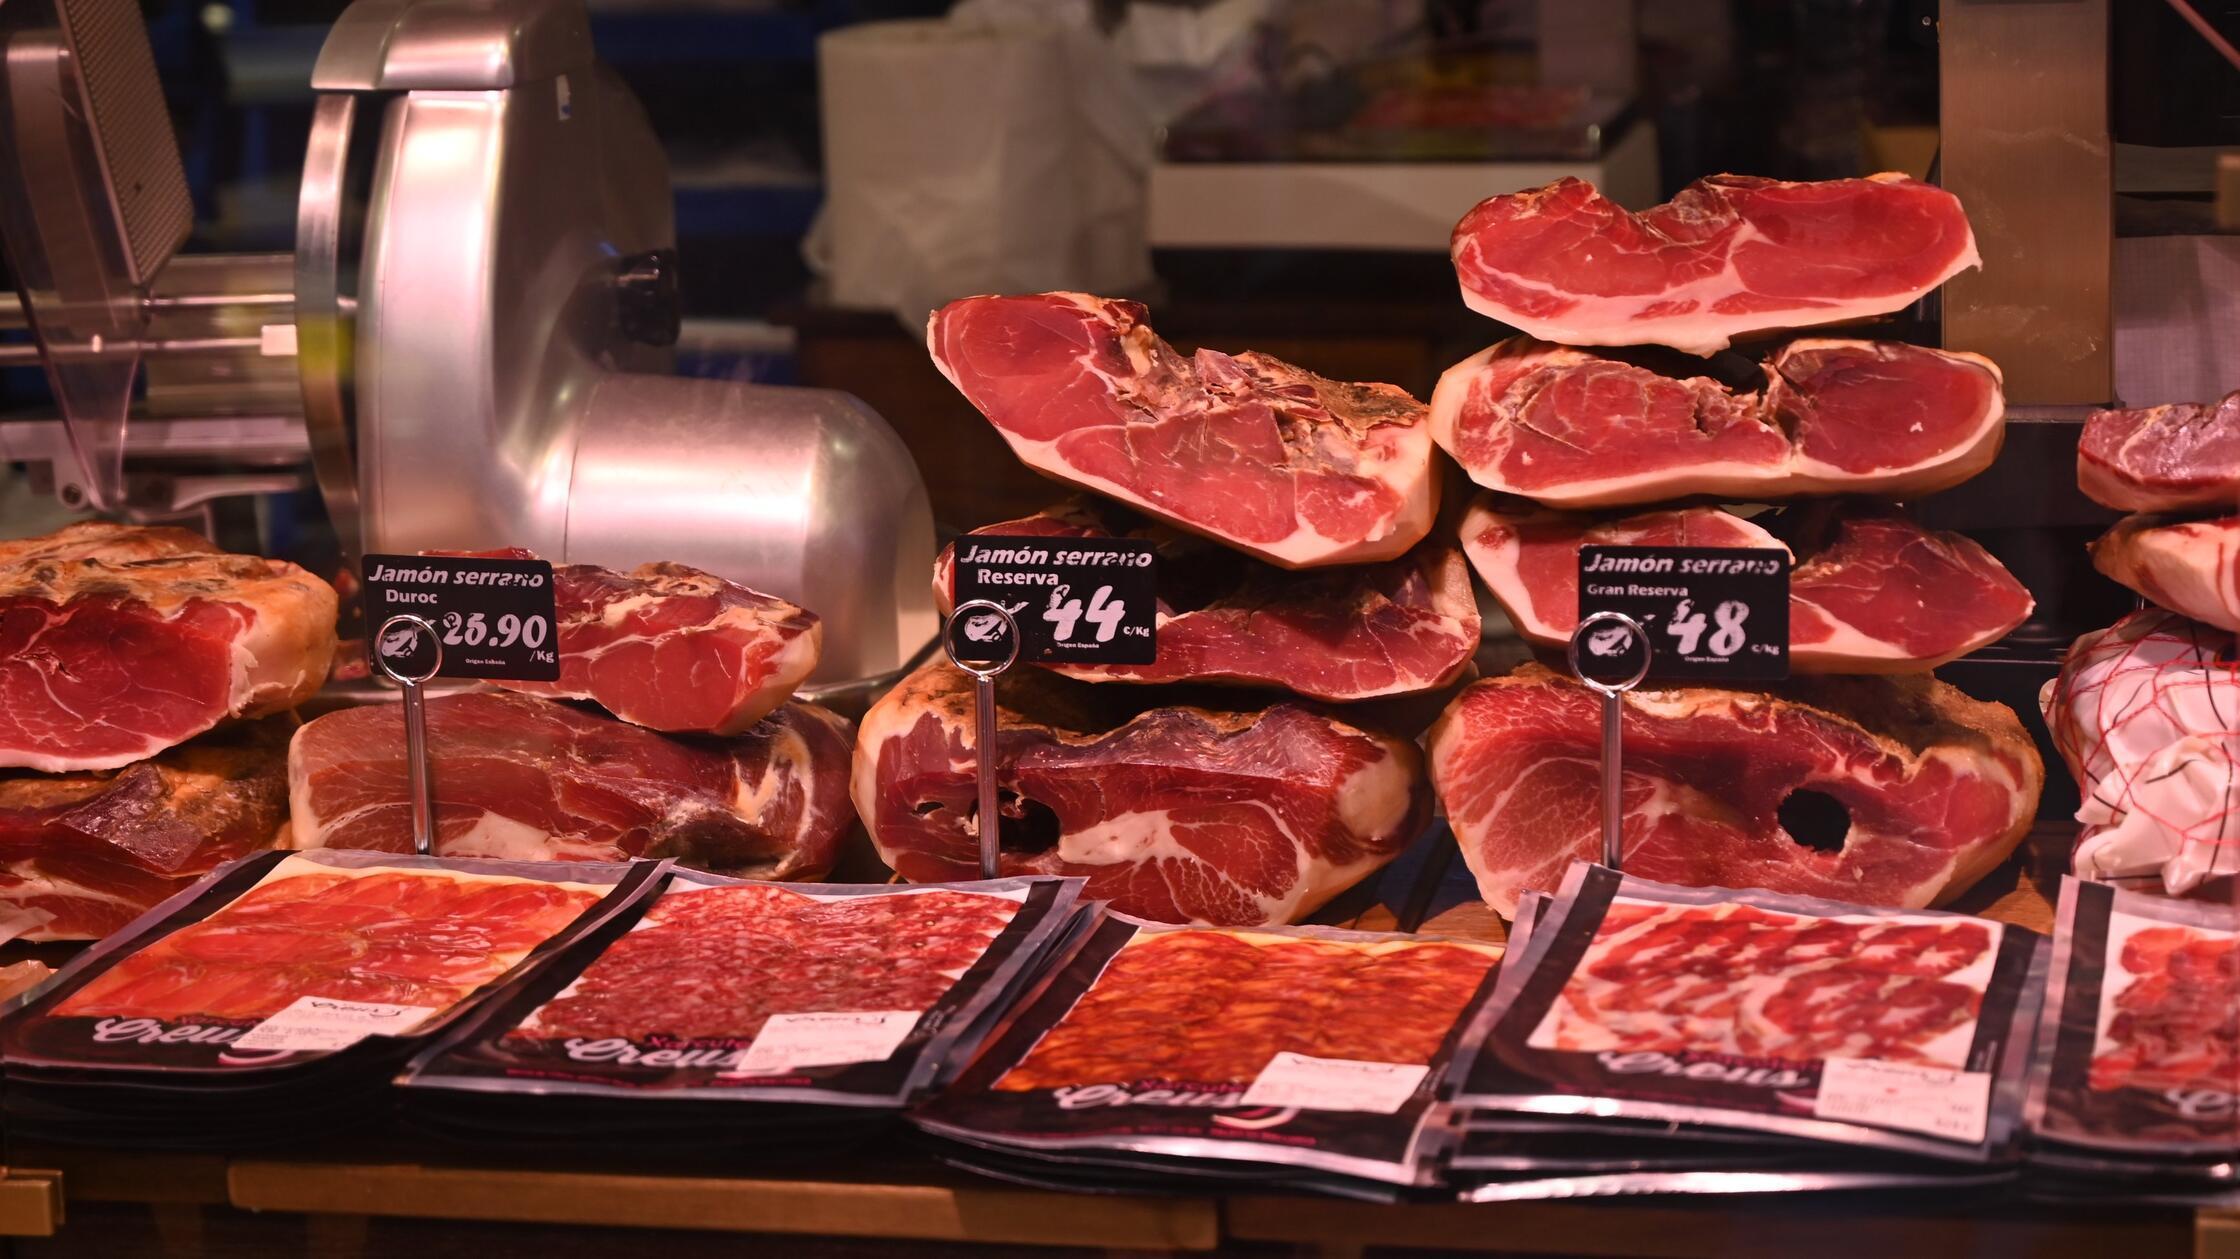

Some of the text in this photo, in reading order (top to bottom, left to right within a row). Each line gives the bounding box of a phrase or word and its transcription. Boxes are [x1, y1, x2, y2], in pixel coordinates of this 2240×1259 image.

[960, 545, 1049, 565] Jamón
[1584, 553, 1675, 573] Jamón
[368, 564, 448, 584] Jamón
[977, 568, 1059, 586] Reserva
[385, 589, 438, 604] Duroc
[1587, 583, 1689, 597] Gran Reserva
[1042, 584, 1126, 642] 44
[442, 611, 555, 663] 25.90 /Kg
[1666, 598, 1750, 656] 48
[92, 1018, 240, 1044] Creu
